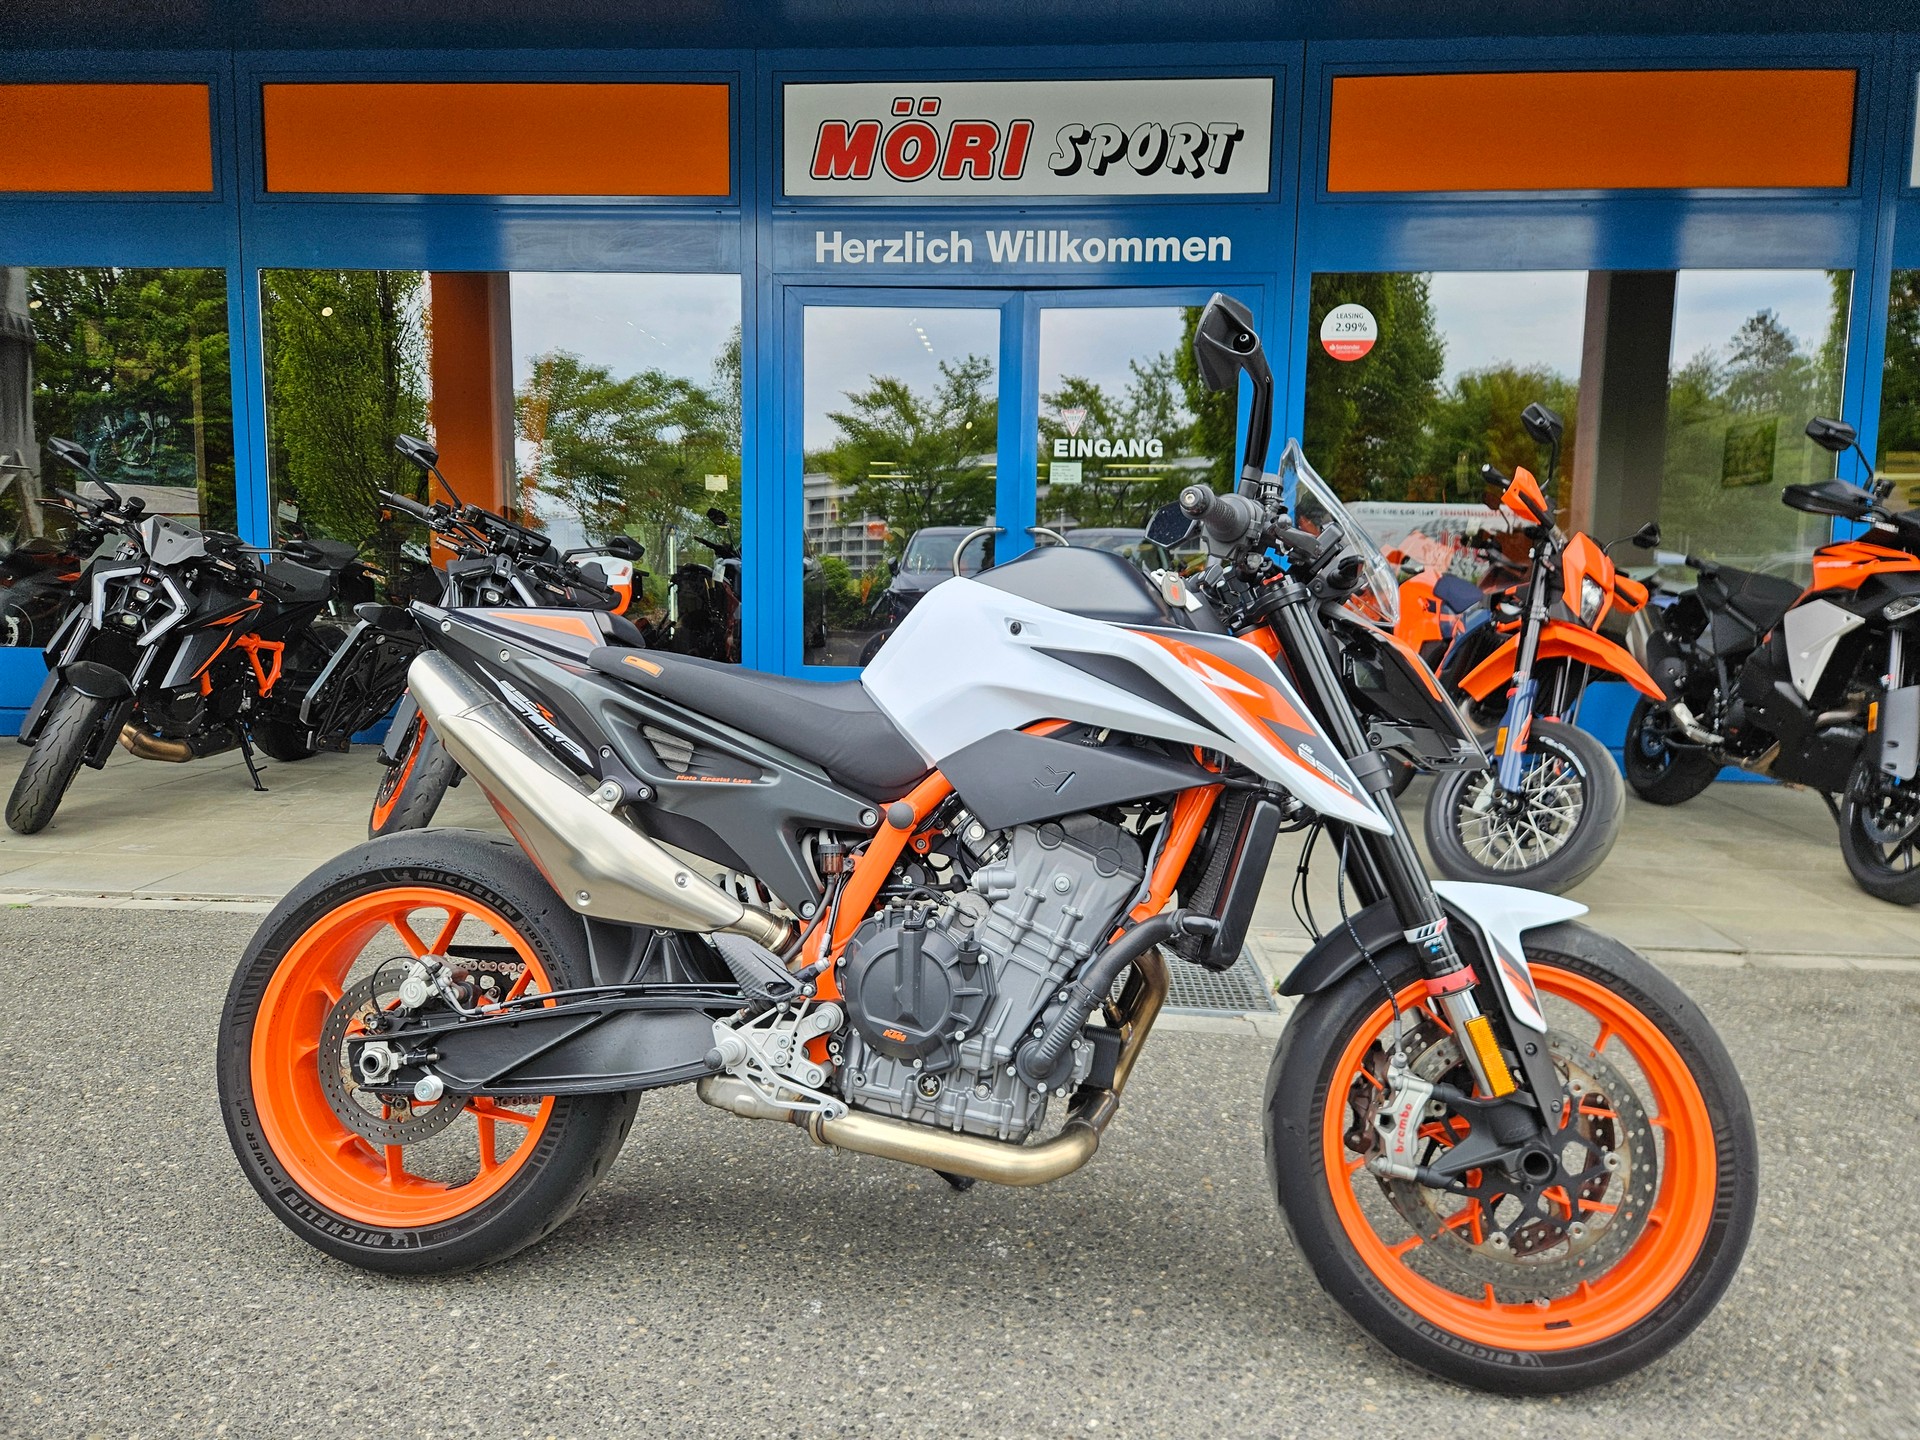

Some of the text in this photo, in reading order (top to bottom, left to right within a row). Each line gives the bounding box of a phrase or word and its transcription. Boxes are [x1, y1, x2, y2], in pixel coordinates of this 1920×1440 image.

[810, 97, 1245, 182] MÖRI SPORT
[815, 230, 1232, 263] Herzlich Willkommen
[1335, 322, 1368, 332] 2.99%
[1054, 438, 1163, 458] EINGANG
[417, 870, 517, 917] MICHELIN
[882, 1028, 907, 1042] KTM
[1394, 1103, 1412, 1153] brembo
[246, 1131, 281, 1186] POWER
[283, 1193, 386, 1246] MICHELIN
[1418, 1321, 1514, 1364] MICHELIN
